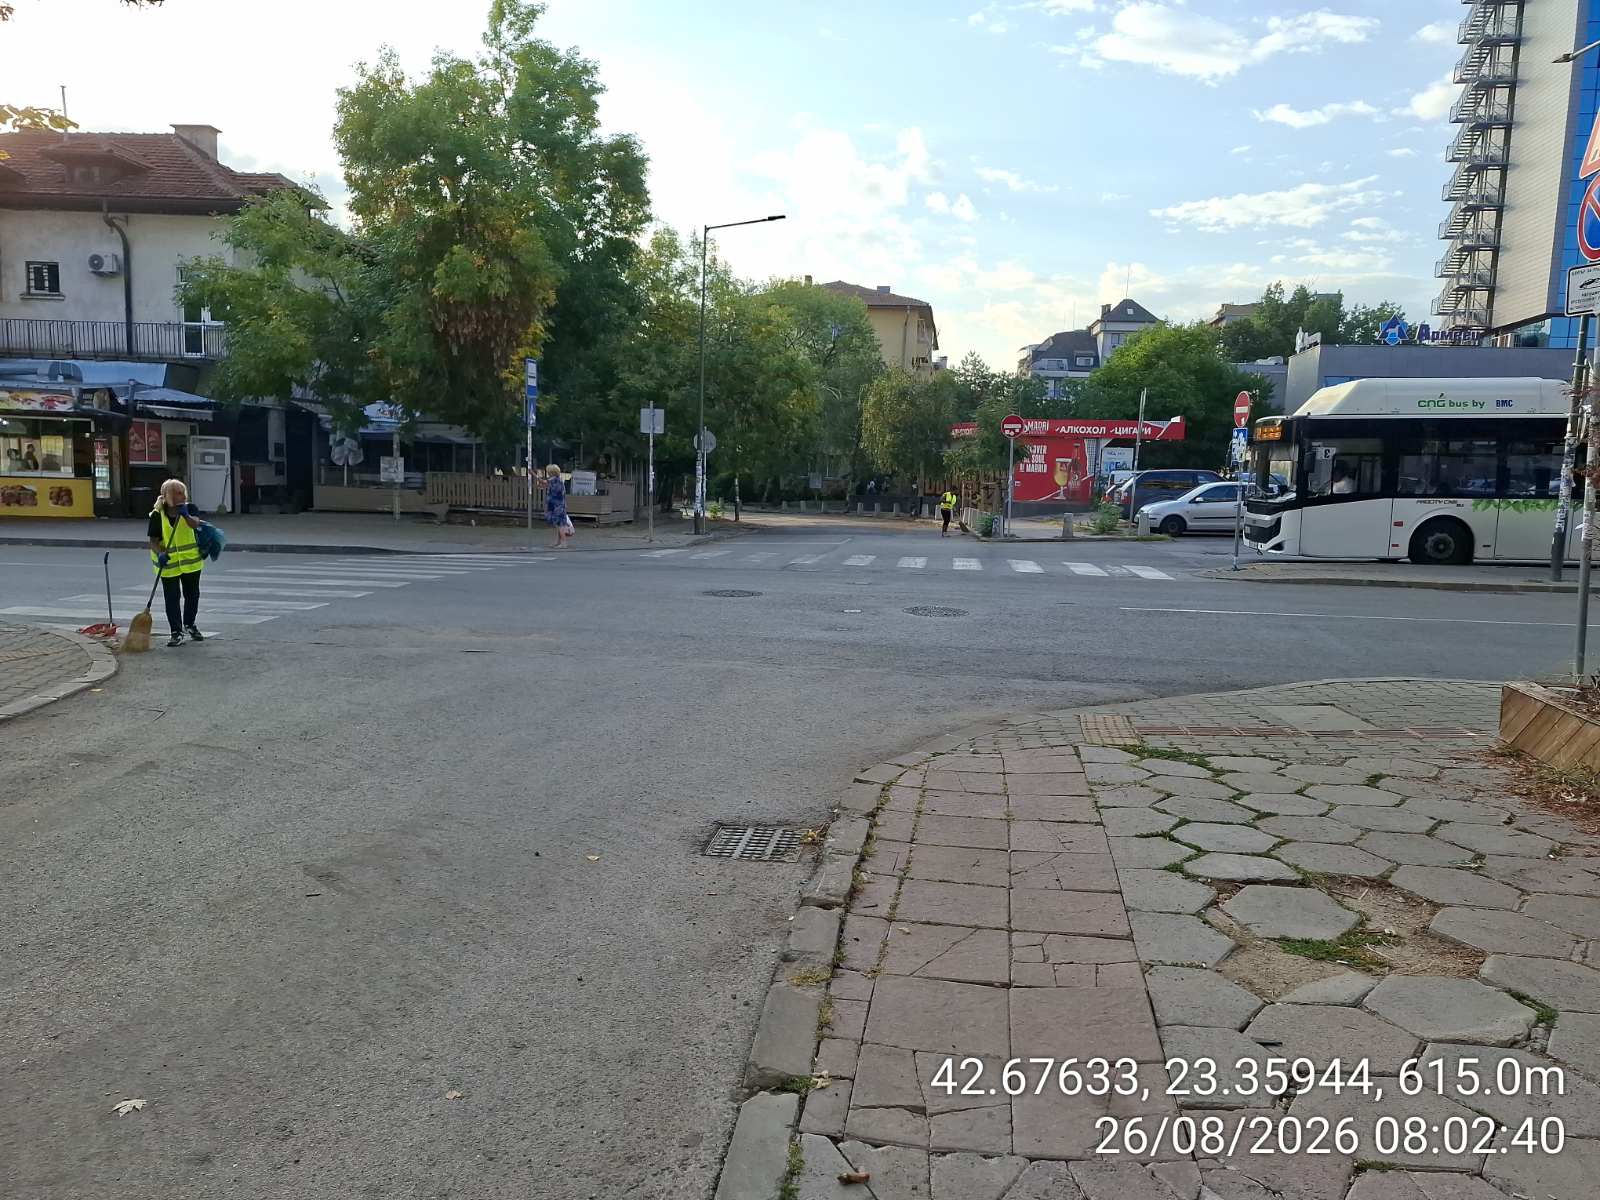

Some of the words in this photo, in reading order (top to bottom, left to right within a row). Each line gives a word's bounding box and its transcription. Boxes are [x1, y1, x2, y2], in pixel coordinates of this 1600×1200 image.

[1448, 399, 1469, 408] bus
[1472, 399, 1486, 409] by
[1495, 399, 1513, 408] BMC
[1059, 425, 1106, 435] АЛКОХОЛ
[1114, 426, 1152, 436] ЦИГАИ
[1026, 463, 1048, 473] MADRID
